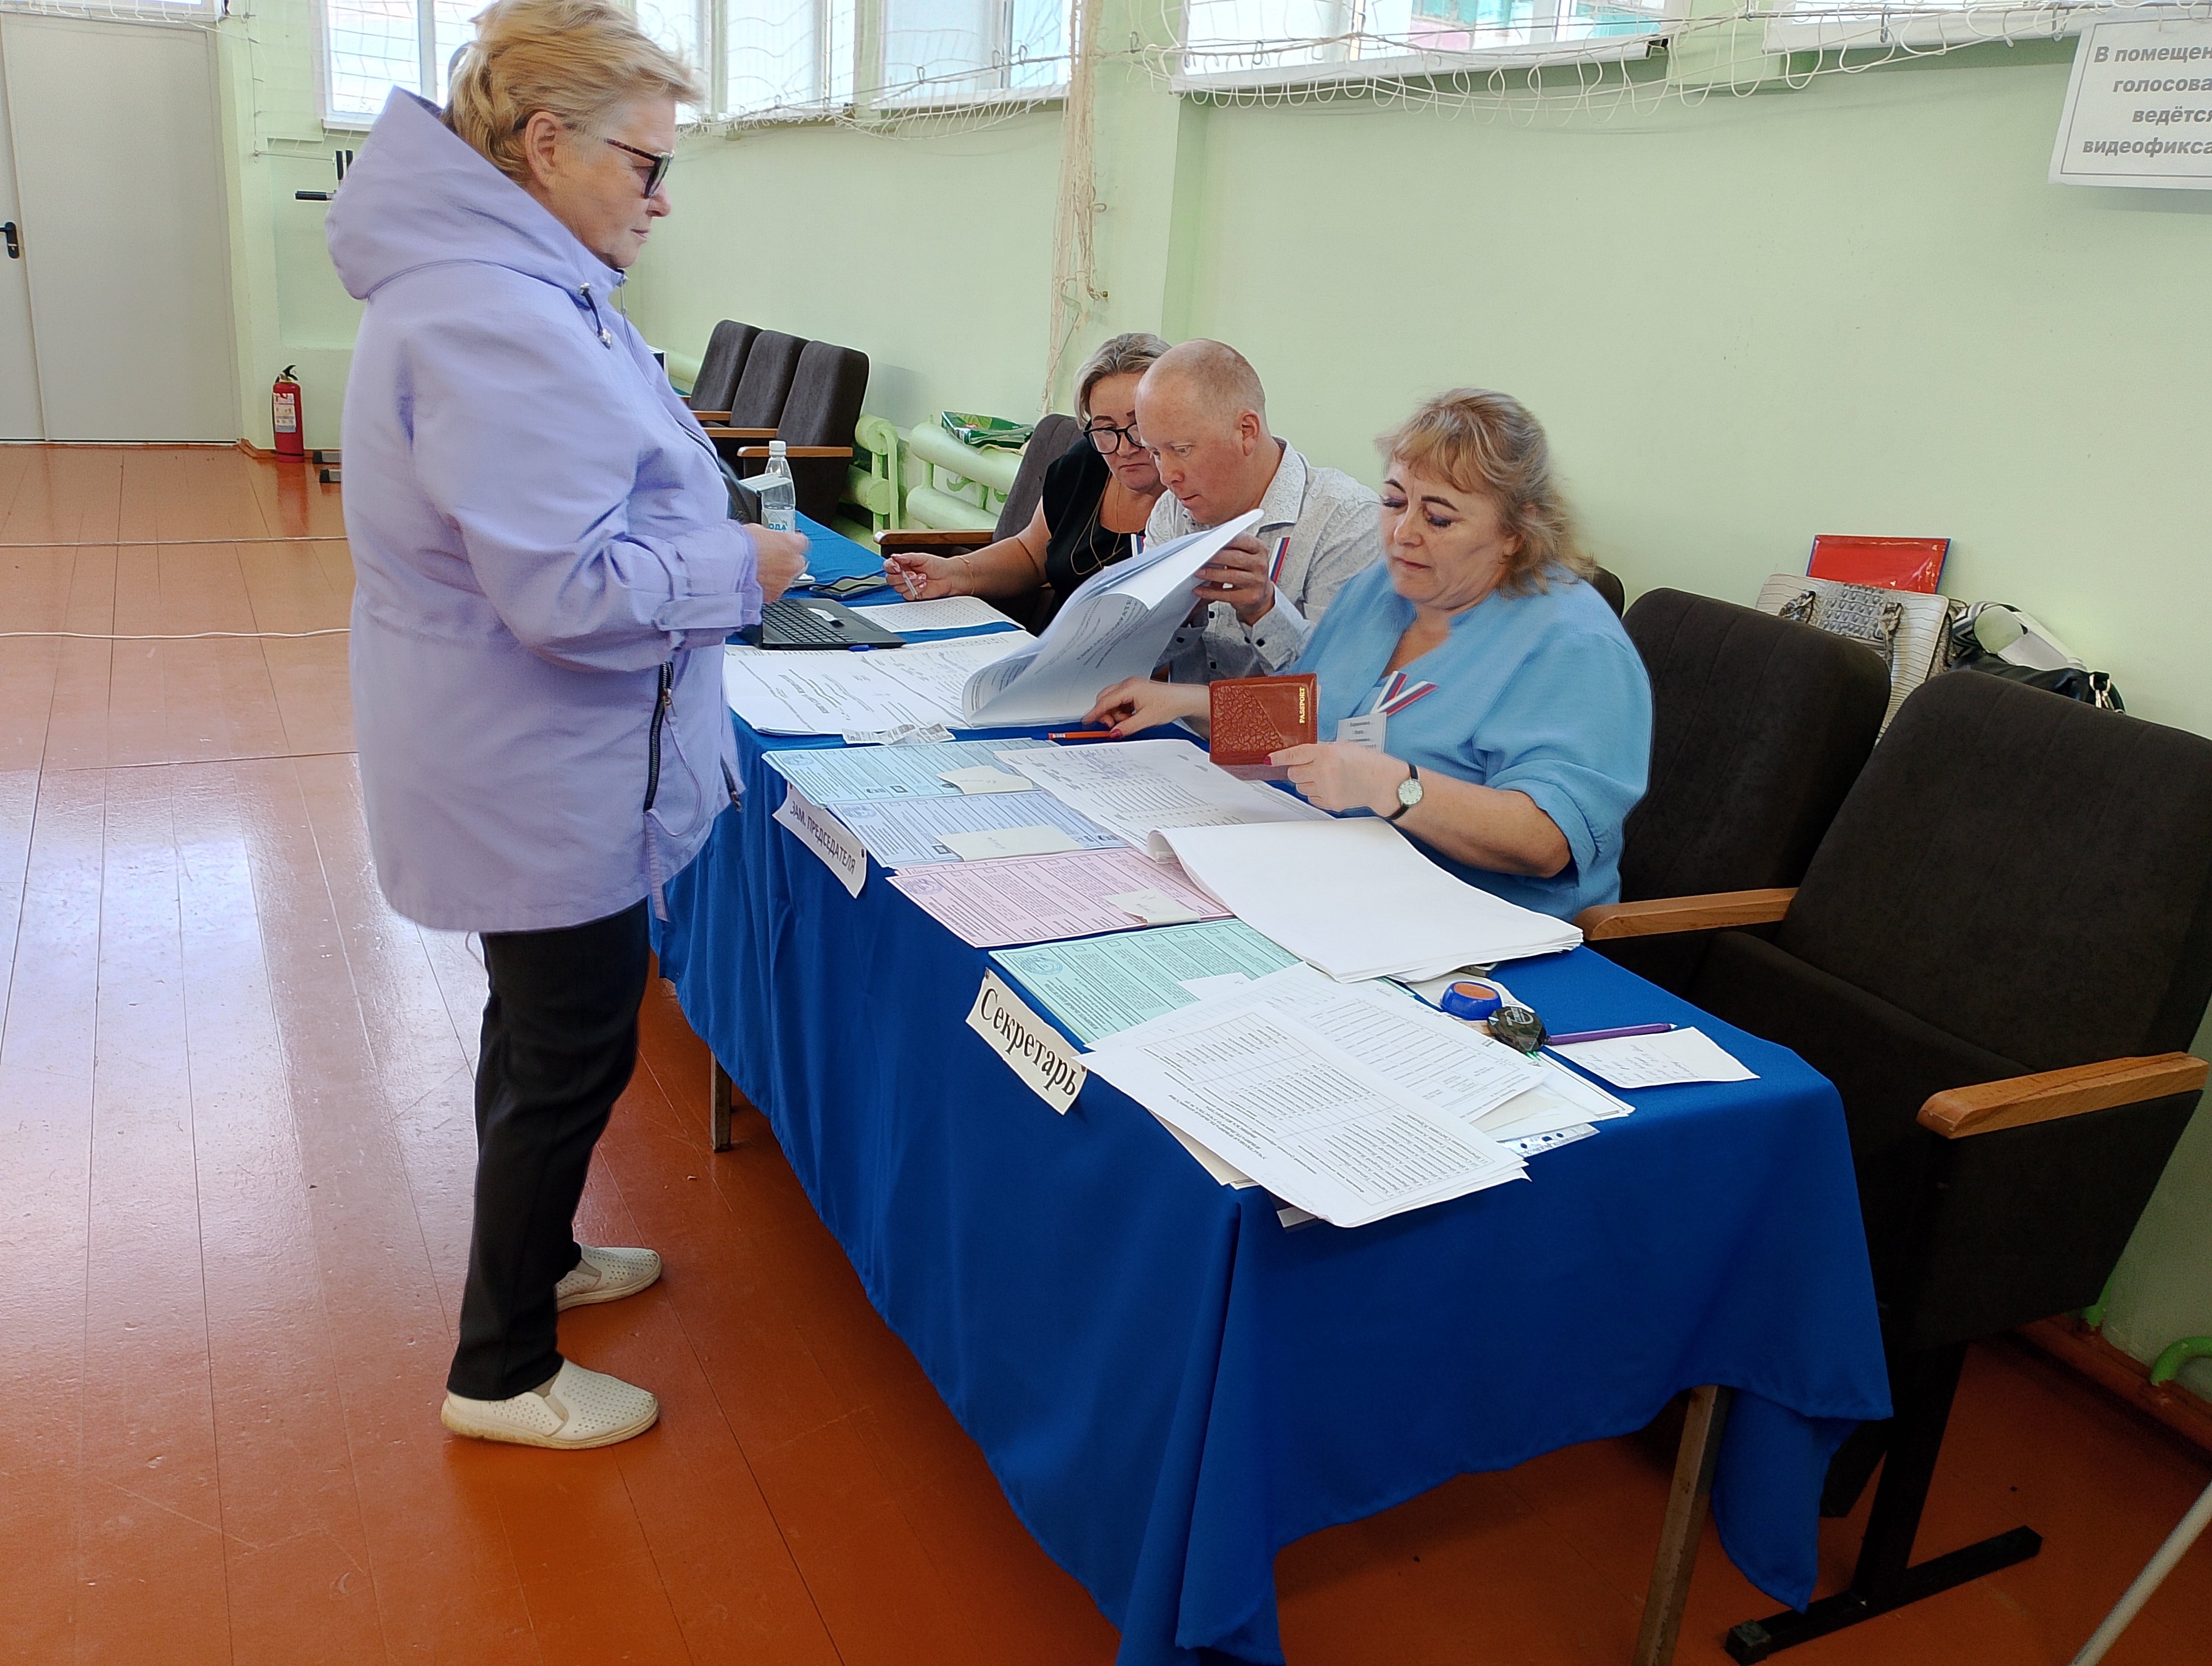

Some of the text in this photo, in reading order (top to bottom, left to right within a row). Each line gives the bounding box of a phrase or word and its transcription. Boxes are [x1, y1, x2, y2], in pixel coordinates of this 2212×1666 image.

[2094, 46, 2212, 63] В помещен
[2113, 78, 2212, 93] голосова
[2082, 137, 2212, 158] видеофикса
[790, 800, 806, 827] ЗАМ.
[807, 816, 856, 875] ПРЕДСЕДАТЕЛЯ
[981, 988, 1077, 1096] Секретарь
